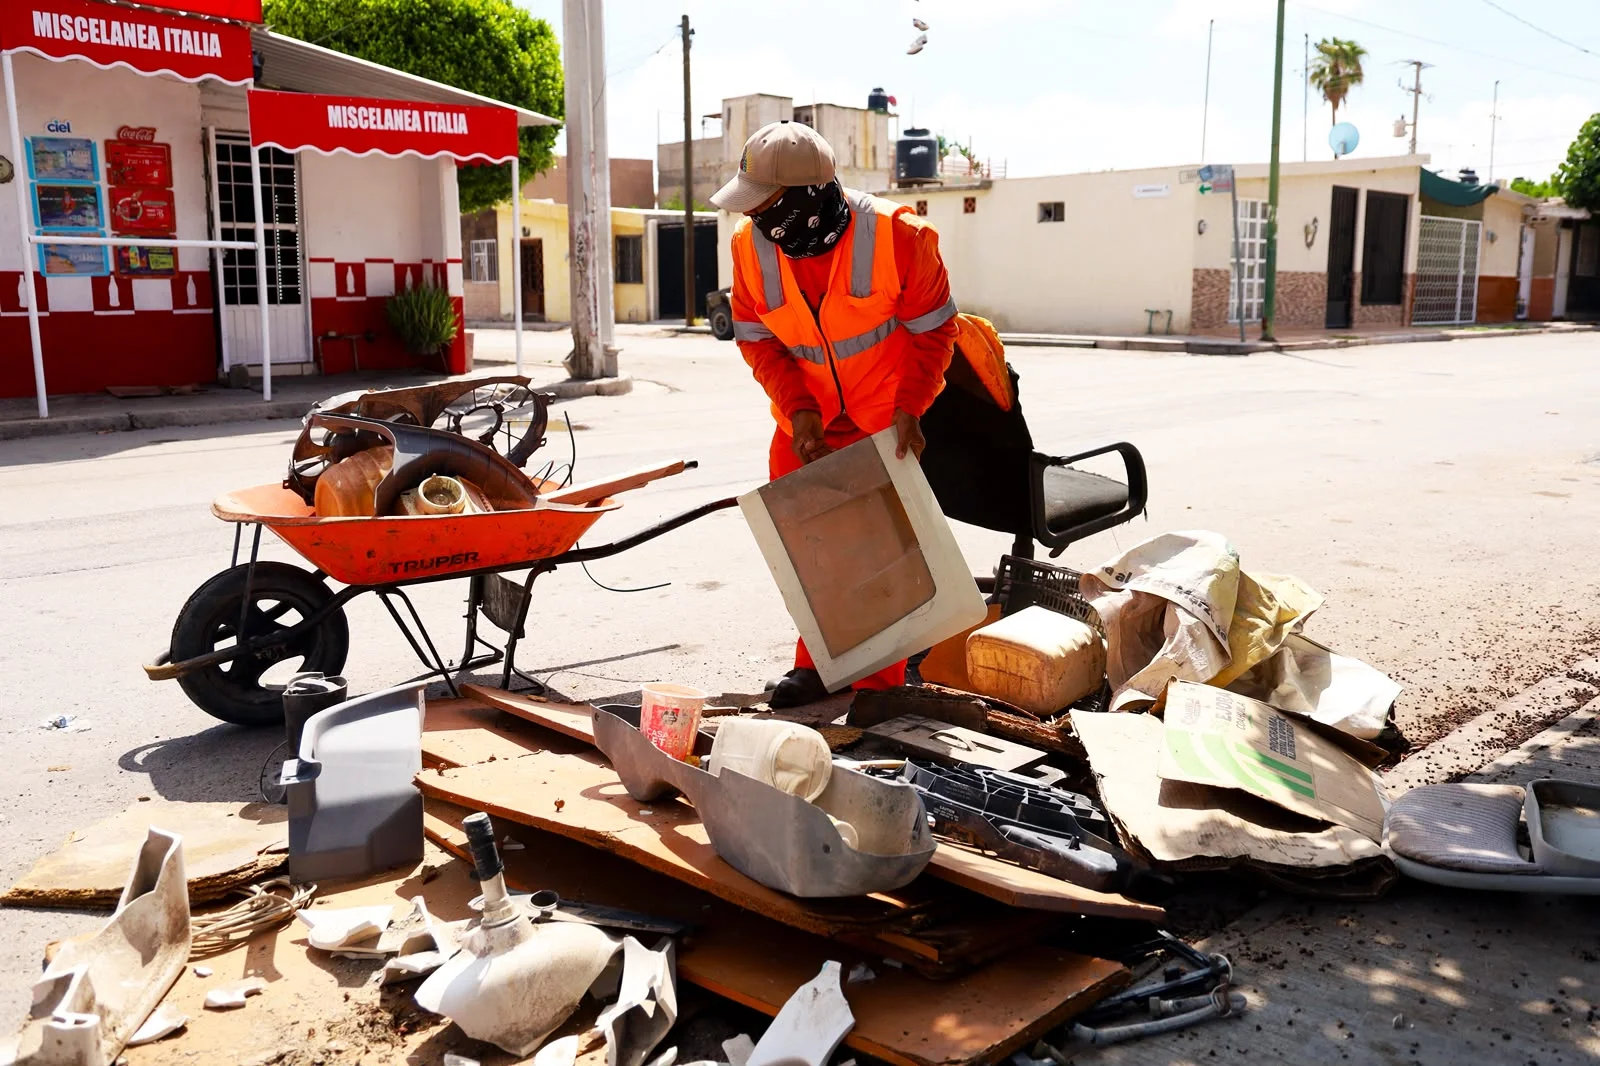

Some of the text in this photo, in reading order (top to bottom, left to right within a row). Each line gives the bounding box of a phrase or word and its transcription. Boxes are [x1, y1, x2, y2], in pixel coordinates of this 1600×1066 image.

[32, 10, 222, 58] MISCELANEA ITALIA
[47, 120, 71, 133] ciel
[327, 104, 469, 135] MISCELANEA ITALIA
[781, 208, 801, 229] PASA
[388, 551, 479, 574] TRUPER
